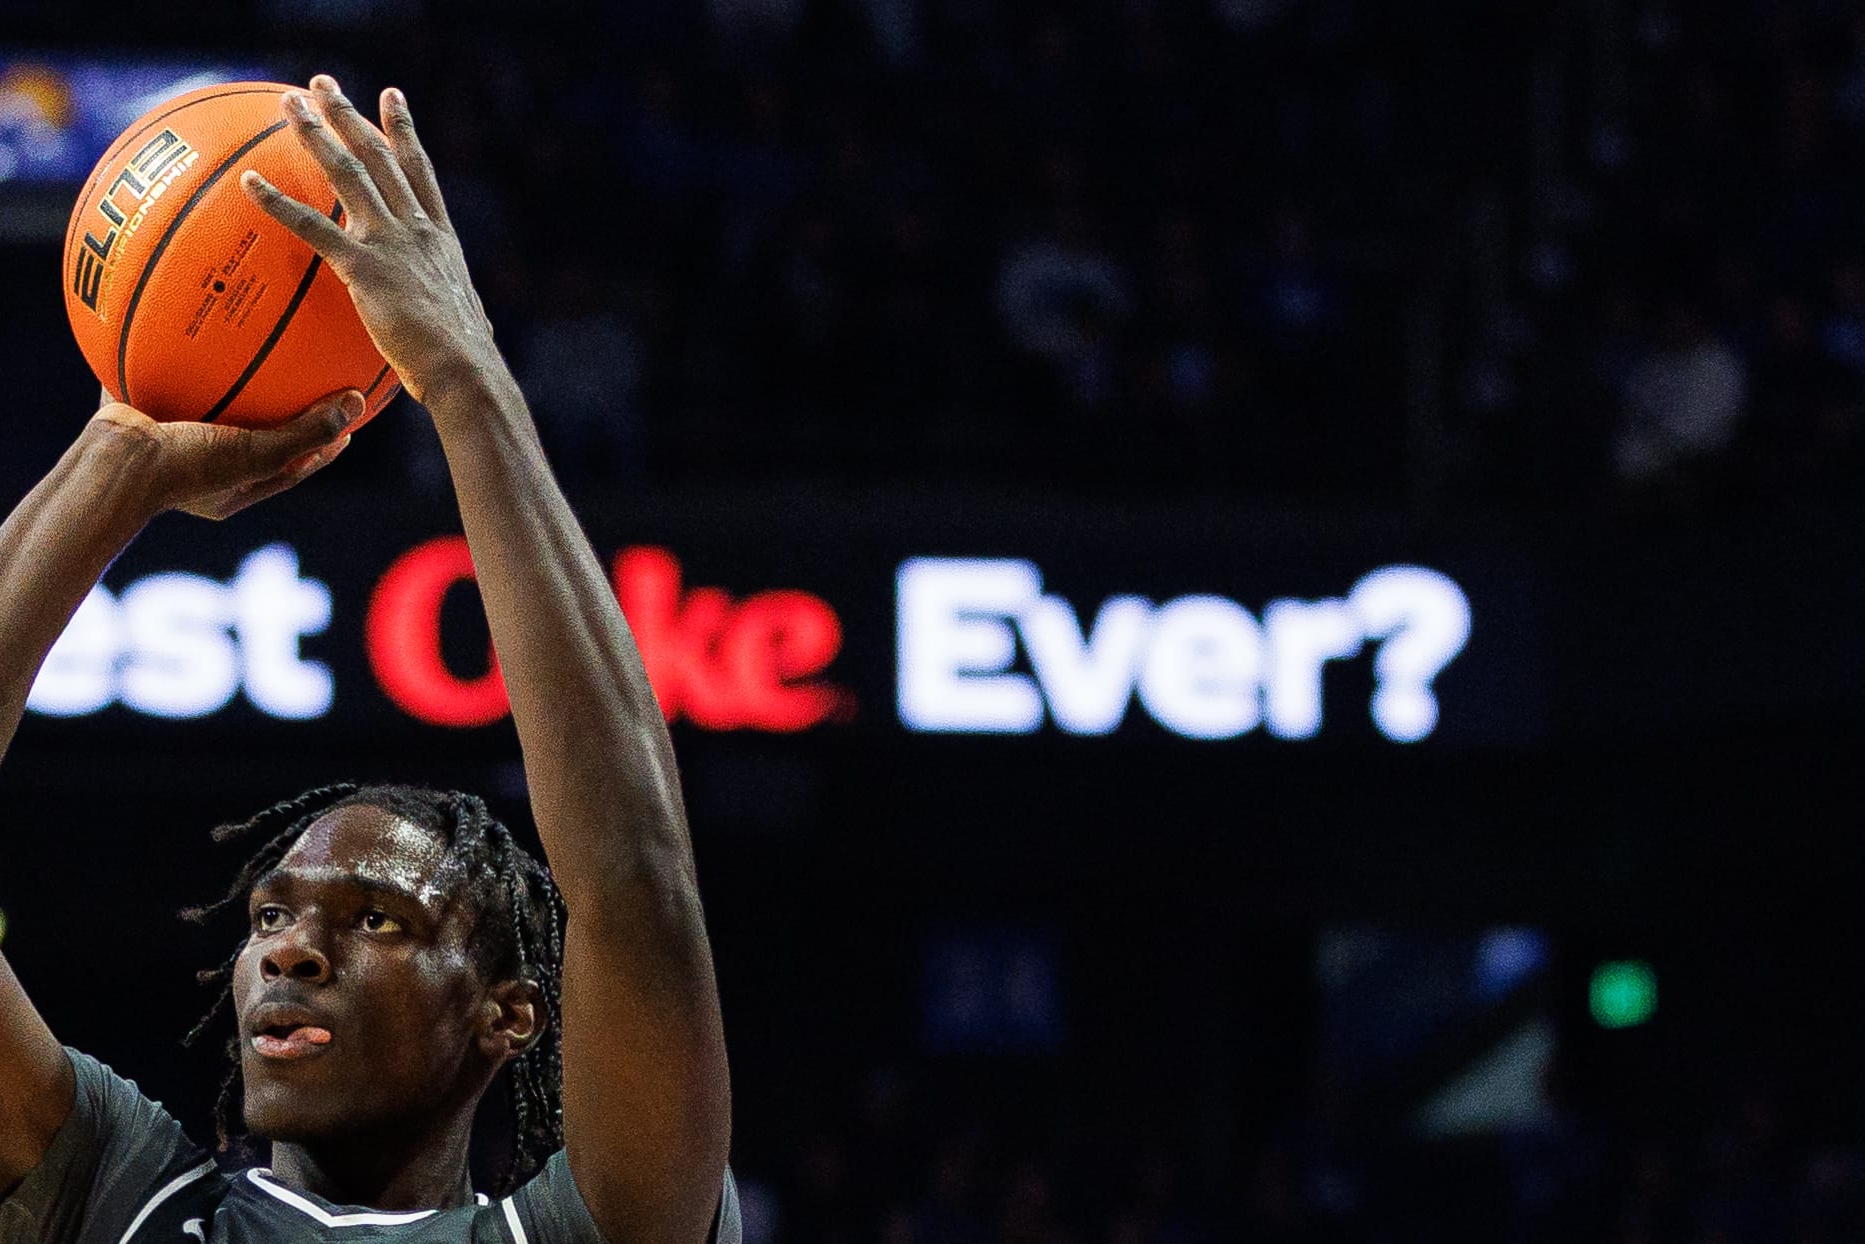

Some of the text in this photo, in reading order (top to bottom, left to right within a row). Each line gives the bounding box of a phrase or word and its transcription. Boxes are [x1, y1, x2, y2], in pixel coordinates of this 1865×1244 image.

[73, 127, 192, 313] ELITE
[98, 149, 200, 322] CMPIONSHIP
[363, 534, 859, 733] Cke
[895, 557, 1471, 741] Ever?
